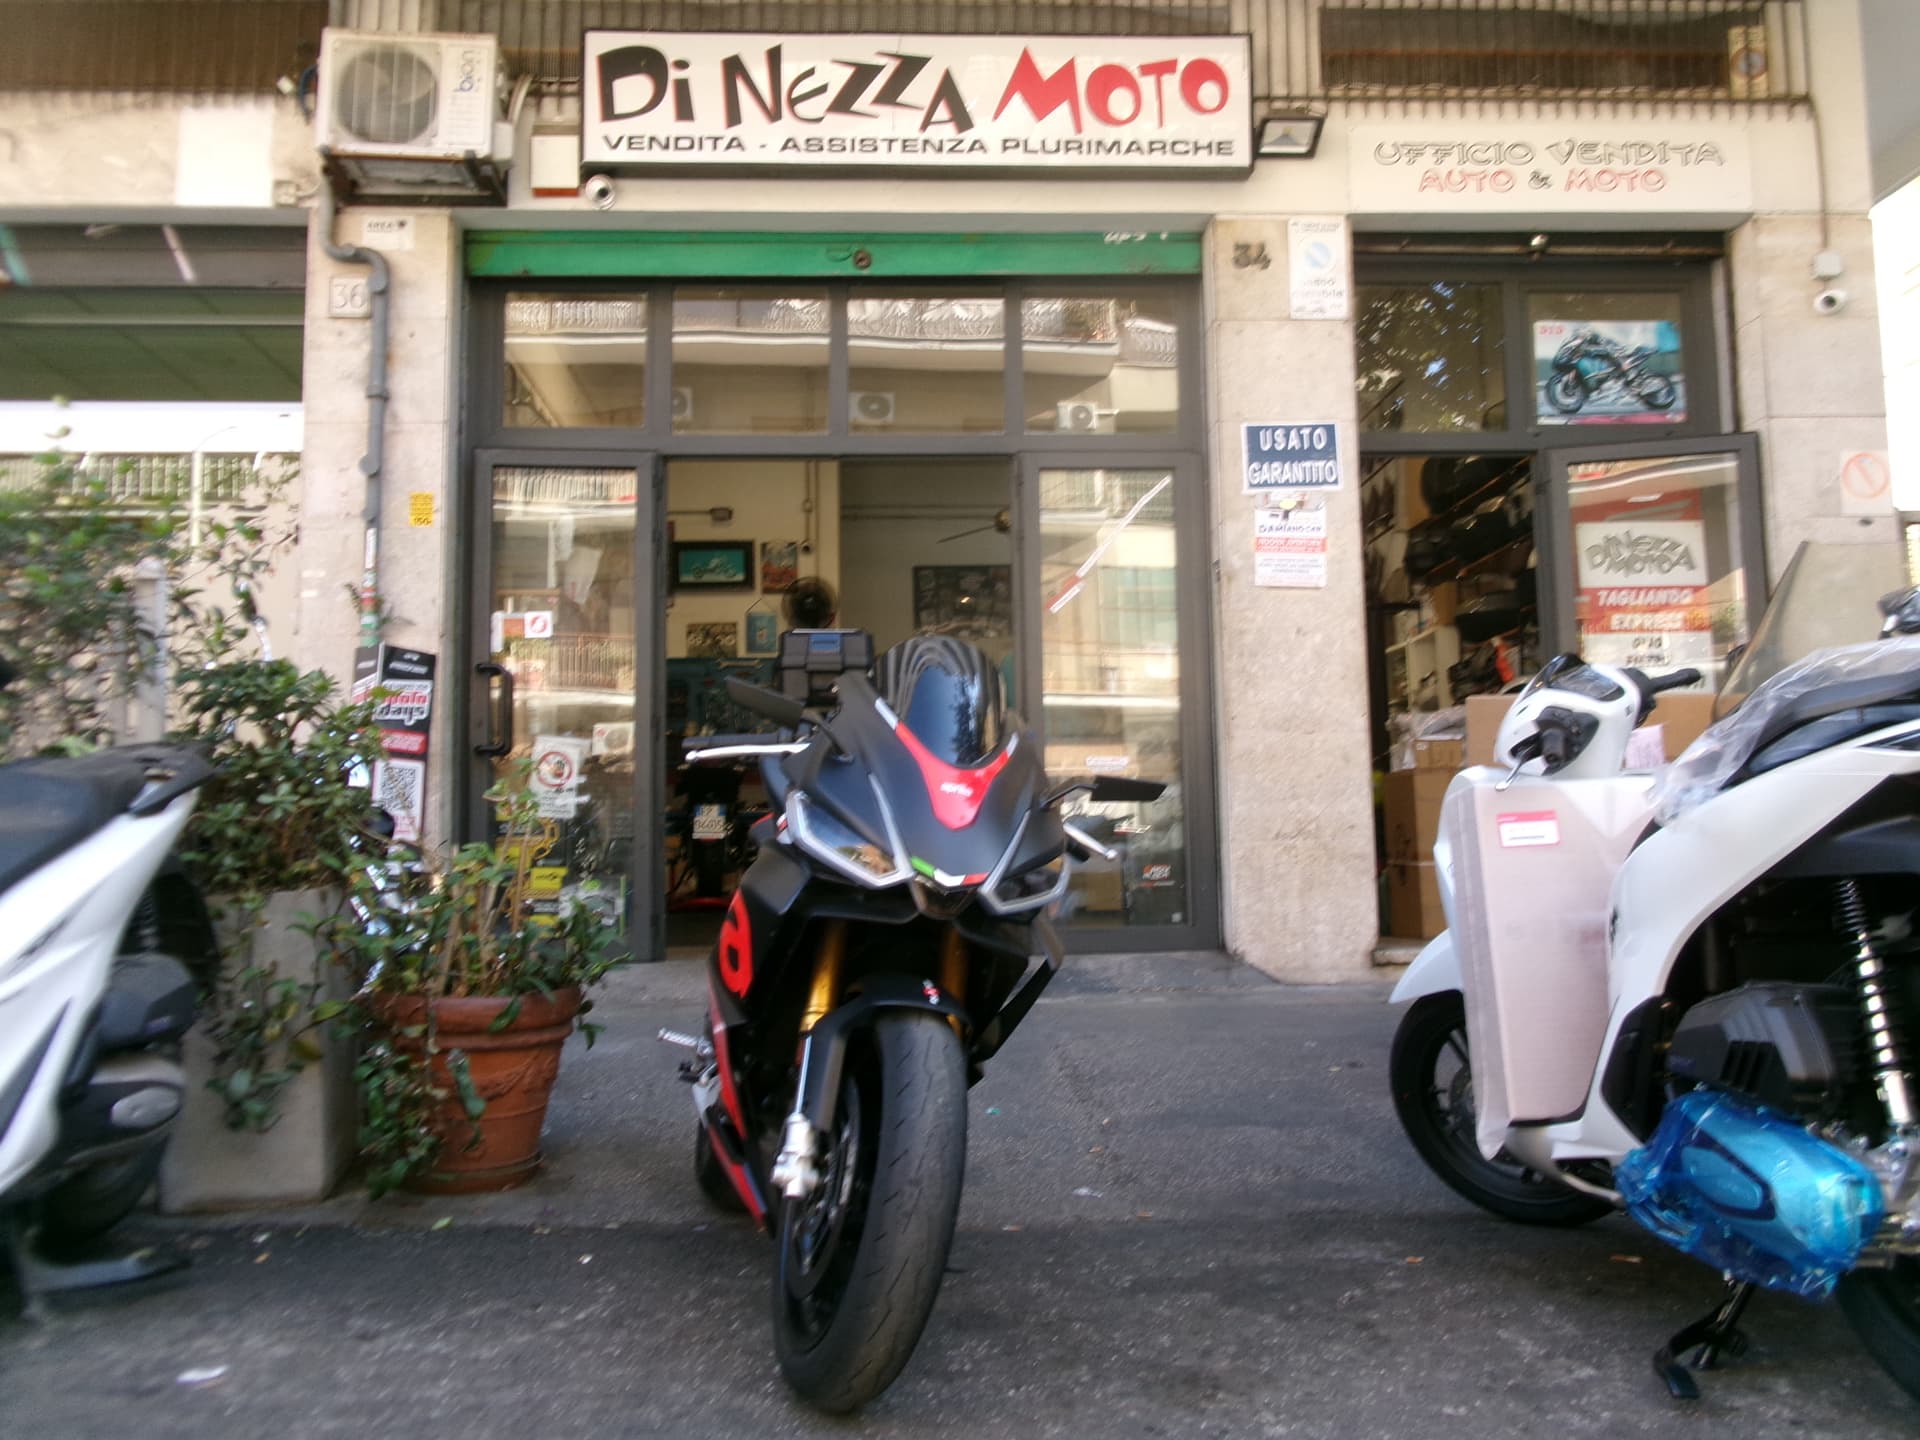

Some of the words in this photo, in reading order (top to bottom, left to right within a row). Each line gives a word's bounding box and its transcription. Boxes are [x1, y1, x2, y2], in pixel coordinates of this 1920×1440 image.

[992, 46, 1230, 135] MOTO
[603, 134, 747, 152] VENDITA
[779, 136, 989, 155] ASSISTENZA
[1001, 138, 1235, 157] PLURIMARCHE
[1374, 141, 1536, 166] UFFICIO
[1546, 139, 1725, 167] VENDITA
[1418, 168, 1517, 193] AUTO
[1528, 169, 1552, 190] &
[1564, 168, 1667, 193] MOTO
[1232, 241, 1272, 271] 34
[334, 283, 369, 309] 36
[1260, 427, 1328, 451] USATO
[1249, 459, 1338, 486] GARANTITO
[1597, 588, 1694, 607] TAGLIANDO
